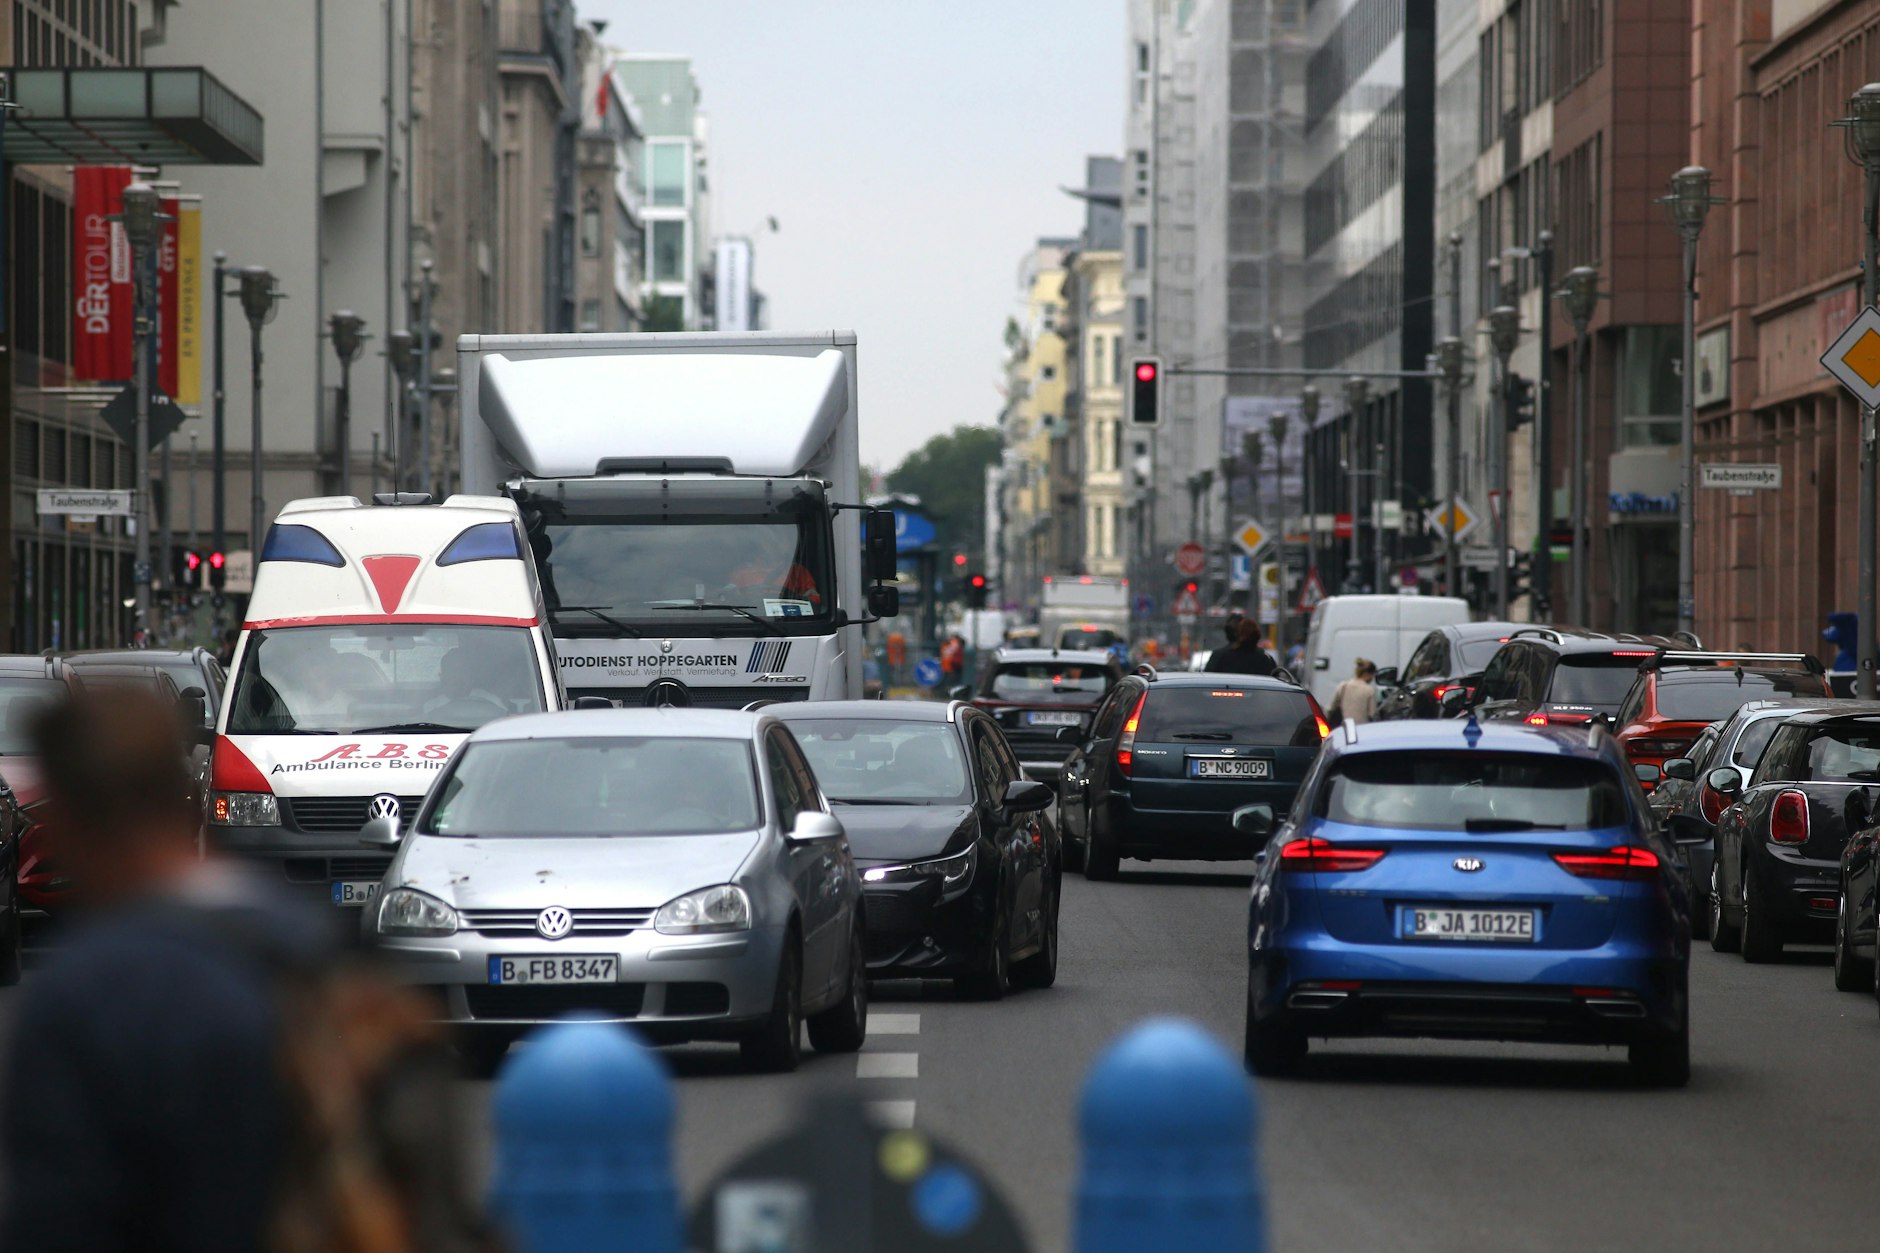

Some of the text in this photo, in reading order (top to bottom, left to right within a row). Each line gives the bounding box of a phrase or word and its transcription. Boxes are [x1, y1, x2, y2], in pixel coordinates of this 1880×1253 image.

[162, 233, 175, 272] CITY
[77, 213, 110, 334] DERTOUR
[1705, 469, 1776, 484] Taubenstraße
[49, 495, 119, 509] Taubenstraße
[559, 655, 737, 668] UTODIENST HOPPEGARTEN
[607, 668, 738, 677] Verkauf. Werkstatt. Vermietung.
[271, 759, 446, 775] Ambulance Berlin
[1200, 762, 1265, 774] B NC 9009
[1456, 857, 1480, 869] KIA
[344, 884, 354, 900] B
[1415, 912, 1531, 935] B JA 1012E
[502, 960, 613, 981] B FB 8347
